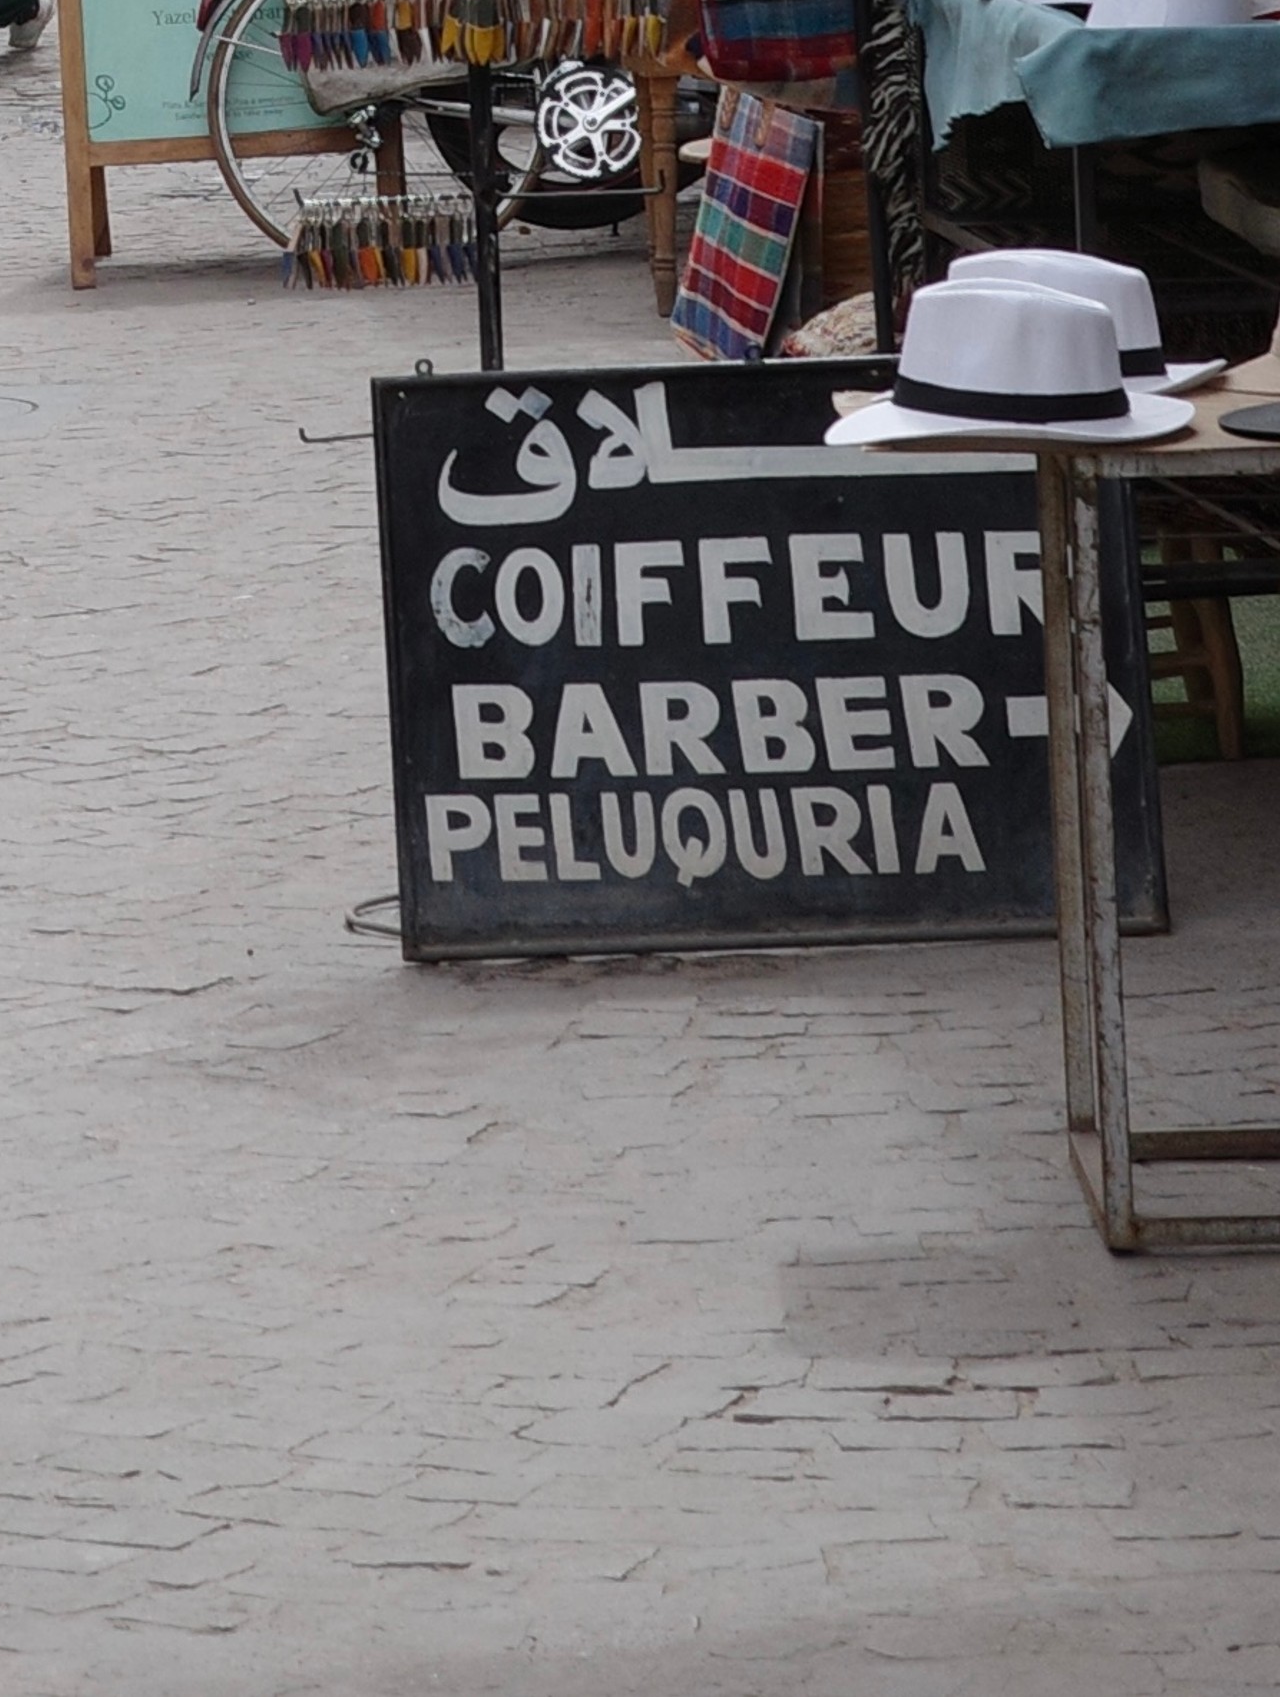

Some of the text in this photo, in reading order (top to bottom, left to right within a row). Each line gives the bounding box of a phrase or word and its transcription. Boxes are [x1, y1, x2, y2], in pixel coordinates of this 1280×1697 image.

[152, 9, 197, 26] Yazel
[429, 529, 1043, 649] COIFFEUR
[450, 672, 991, 780] BARBER
[423, 781, 987, 888] PELUQURIA
